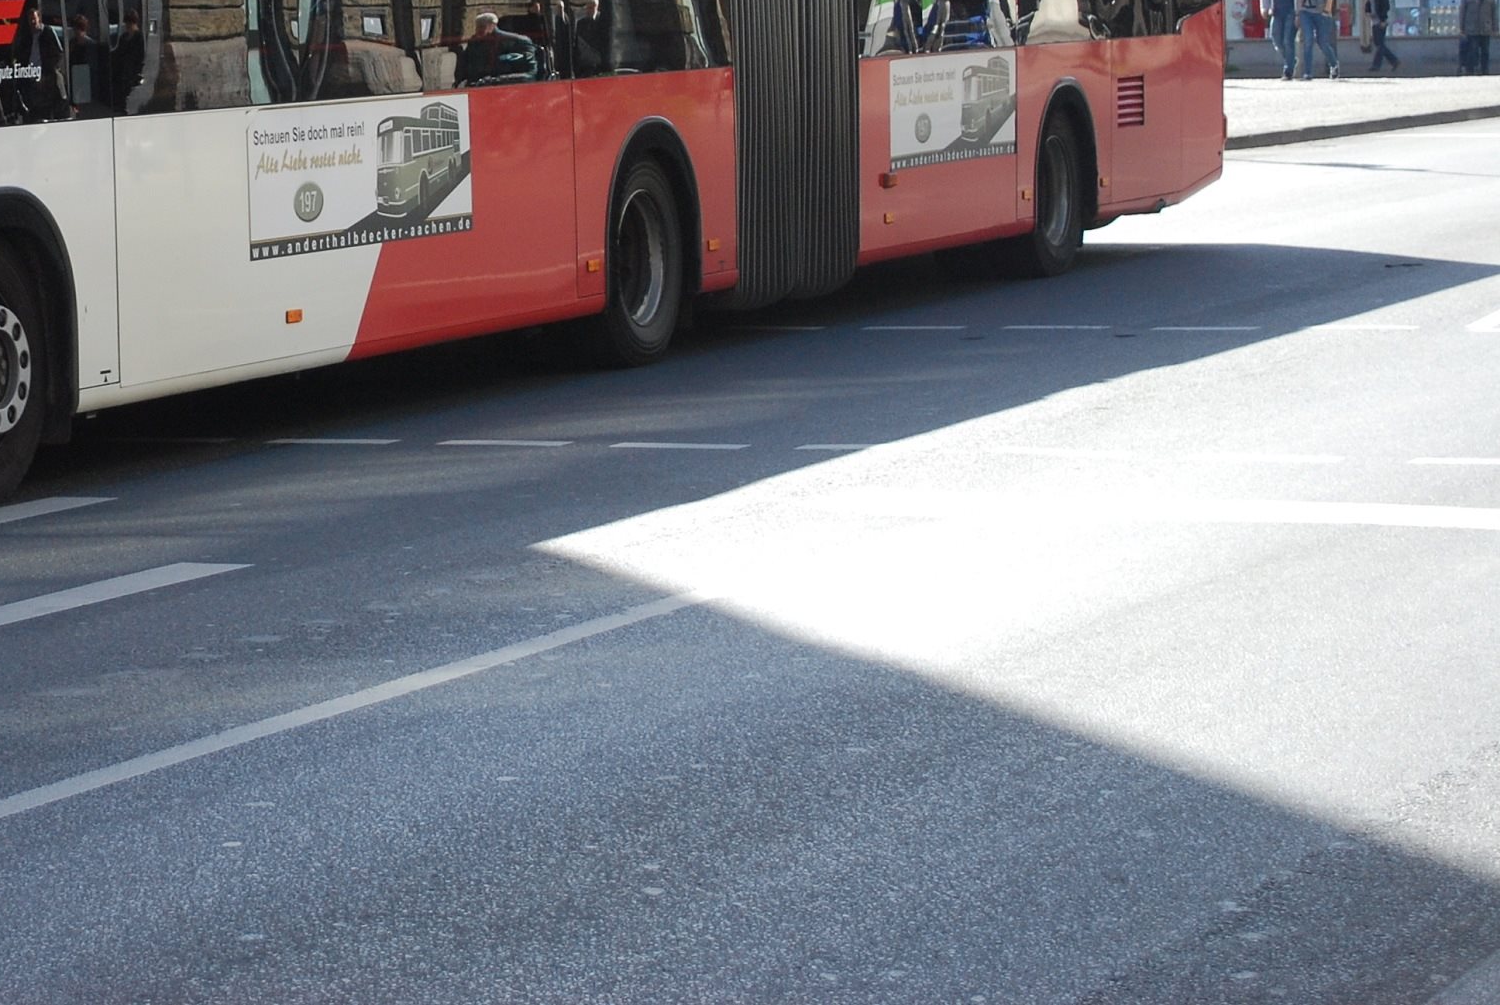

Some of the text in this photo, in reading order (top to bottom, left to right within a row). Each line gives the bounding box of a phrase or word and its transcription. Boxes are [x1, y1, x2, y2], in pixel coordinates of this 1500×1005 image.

[14, 62, 42, 82] Einstieg
[253, 121, 364, 146] Schauen Sie doch mal rein!
[255, 152, 279, 180] Alte
[281, 149, 308, 172] Liebe
[310, 151, 336, 170] rostet
[299, 190, 318, 213] 197
[253, 219, 471, 259] www.anderthalbdecker-aachen.de
